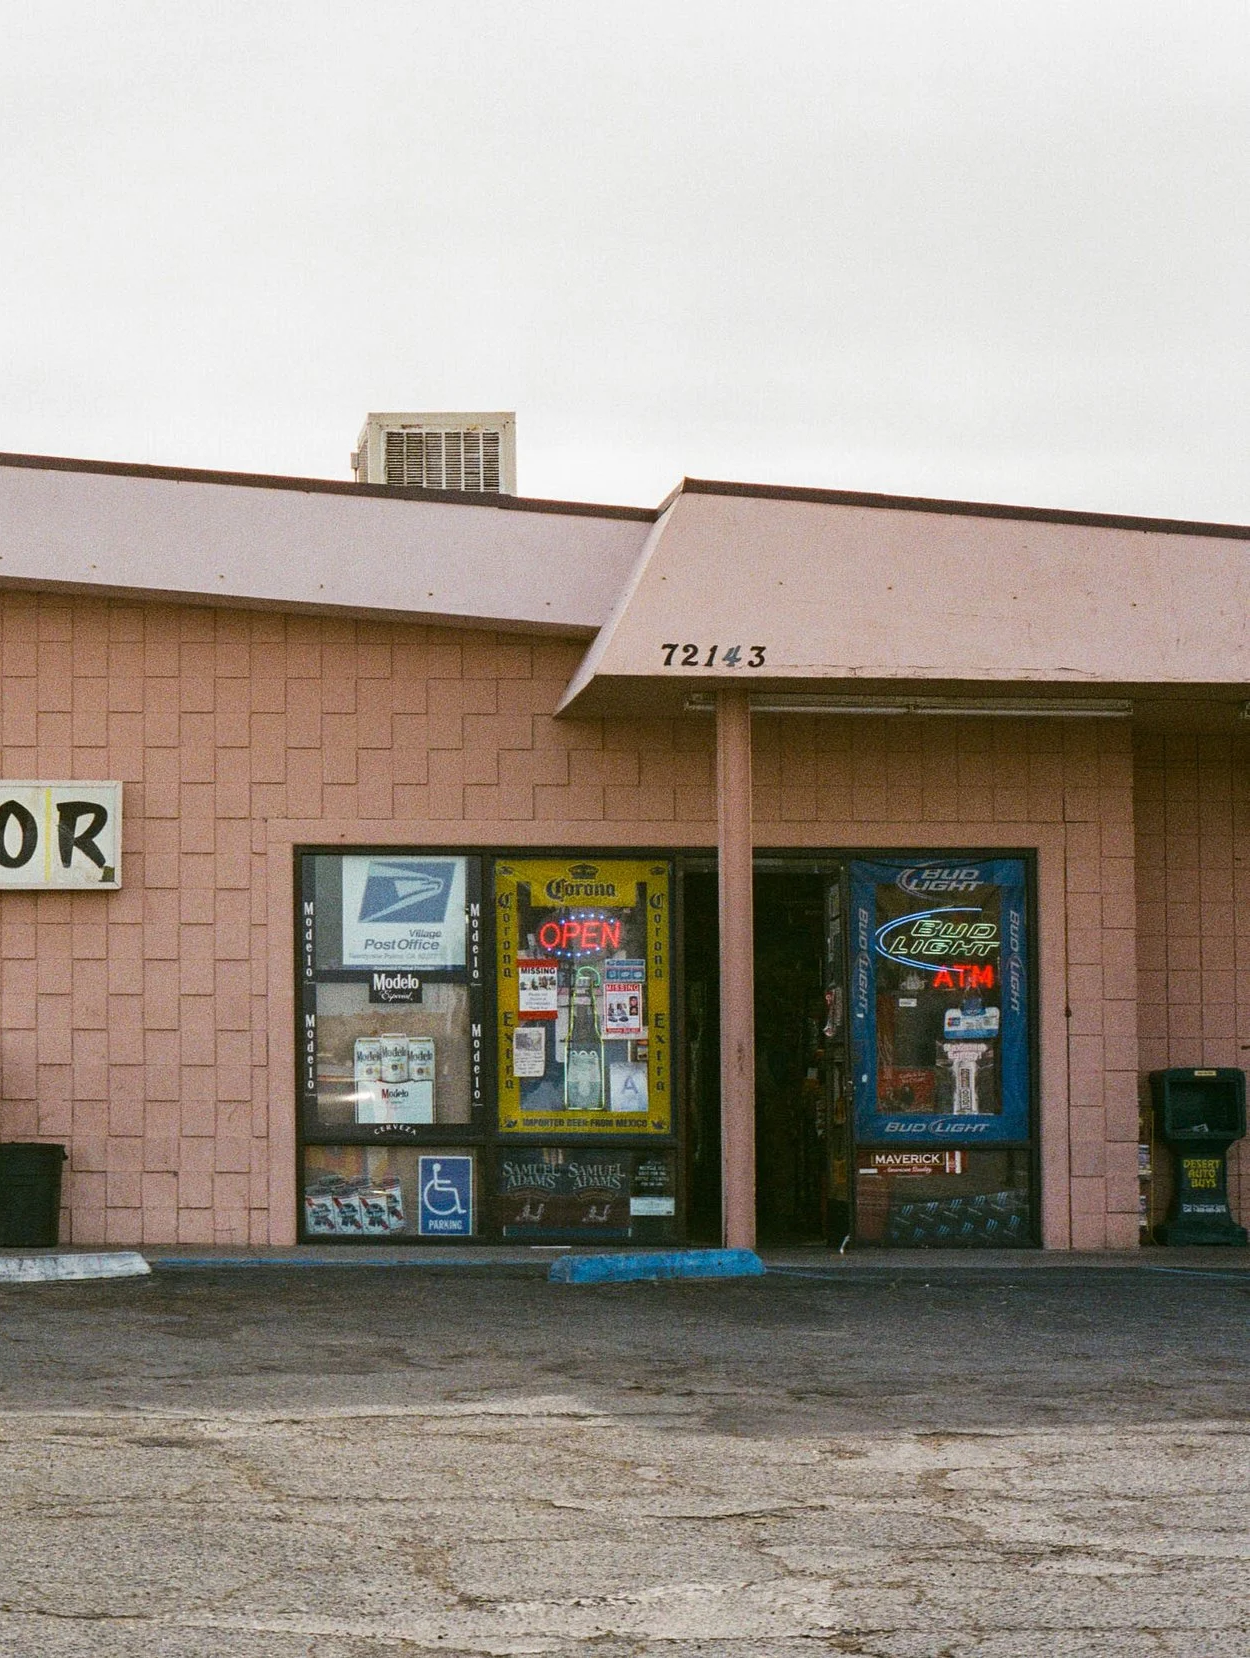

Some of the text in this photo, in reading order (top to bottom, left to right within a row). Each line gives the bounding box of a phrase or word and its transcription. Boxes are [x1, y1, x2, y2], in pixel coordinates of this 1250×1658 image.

[661, 643, 766, 668] 72143
[921, 868, 981, 880] BUD
[545, 877, 618, 902] Corona
[910, 880, 983, 892] LIGHT
[409, 929, 442, 938] Village
[498, 892, 514, 979] Corona
[539, 921, 622, 949] OPEN
[650, 892, 665, 979] Corona
[910, 919, 997, 939] BUD
[304, 902, 314, 977] Modelo
[364, 938, 440, 951] Post Office
[470, 903, 480, 979] Modelo
[889, 936, 1000, 956] LIGHT
[858, 907, 869, 1014] BUD LIGHT
[1009, 909, 1020, 1015] BUD LIGHT
[520, 967, 556, 975] MISSING
[932, 964, 994, 989] ATM
[373, 973, 419, 991] Modelo
[606, 984, 639, 992] MISSING
[305, 1014, 315, 1090] Modelo
[653, 1012, 666, 1092] Extra
[472, 1023, 482, 1099] Modelo
[381, 1088, 409, 1099] Modelo
[373, 1123, 417, 1136] CERVEZA
[523, 1118, 564, 1127] IMPORTED
[590, 1119, 613, 1127] FROM
[884, 1122, 991, 1133] BUD LIGHT
[875, 1153, 940, 1164] MAVERICK
[1183, 1159, 1220, 1168] DESERT
[503, 1161, 561, 1177] SAMUEL
[568, 1162, 626, 1178] SAMUEL
[1188, 1169, 1216, 1178] AUTO
[507, 1175, 556, 1190] ADAMS
[573, 1175, 622, 1190] ADAMS
[1191, 1178, 1217, 1188] BUYS
[428, 1219, 463, 1230] PARKING
